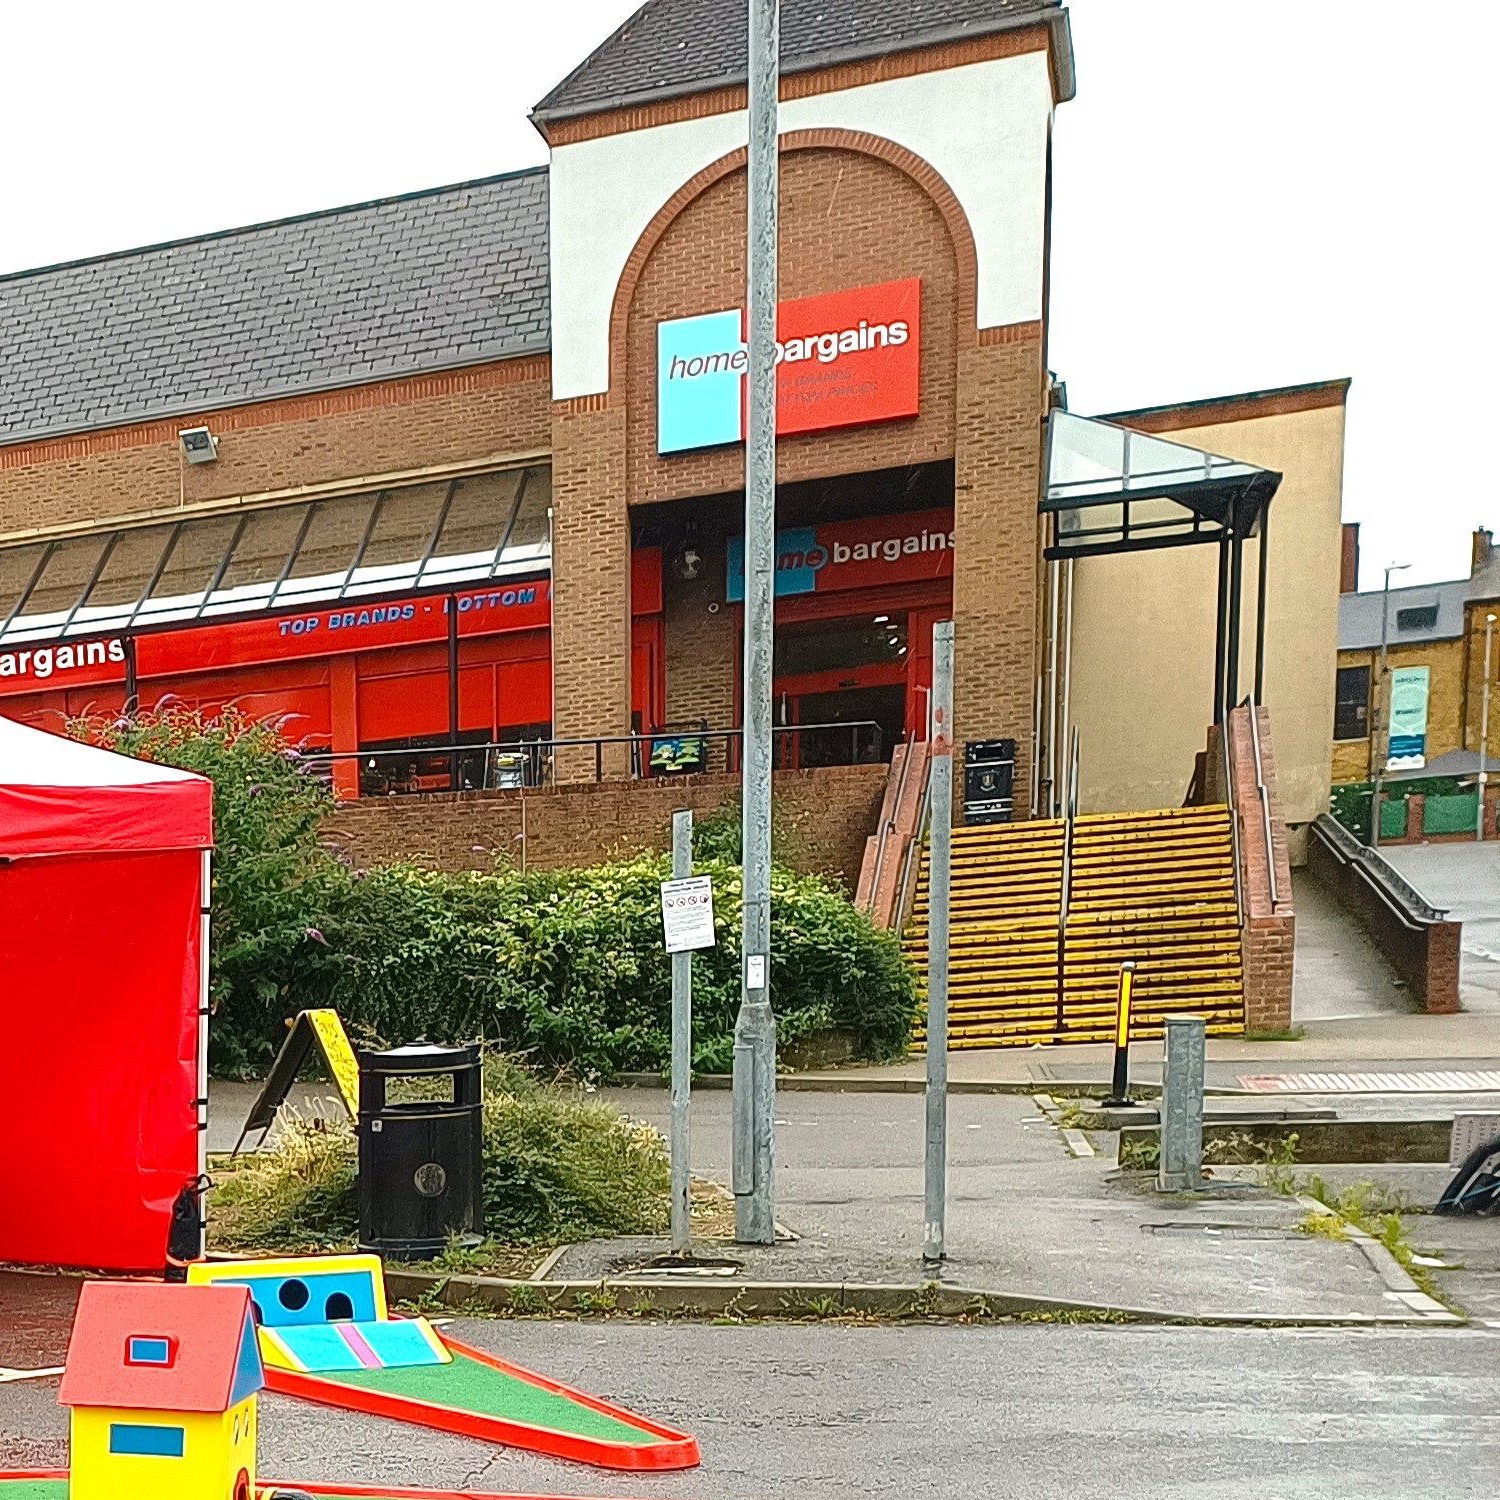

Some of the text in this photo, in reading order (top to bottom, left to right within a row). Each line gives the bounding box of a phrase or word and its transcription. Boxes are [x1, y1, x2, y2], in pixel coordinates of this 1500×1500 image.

[669, 349, 747, 380] home
[778, 550, 823, 571] me
[278, 618, 319, 636] TOP
[328, 604, 415, 630] BRANDS
